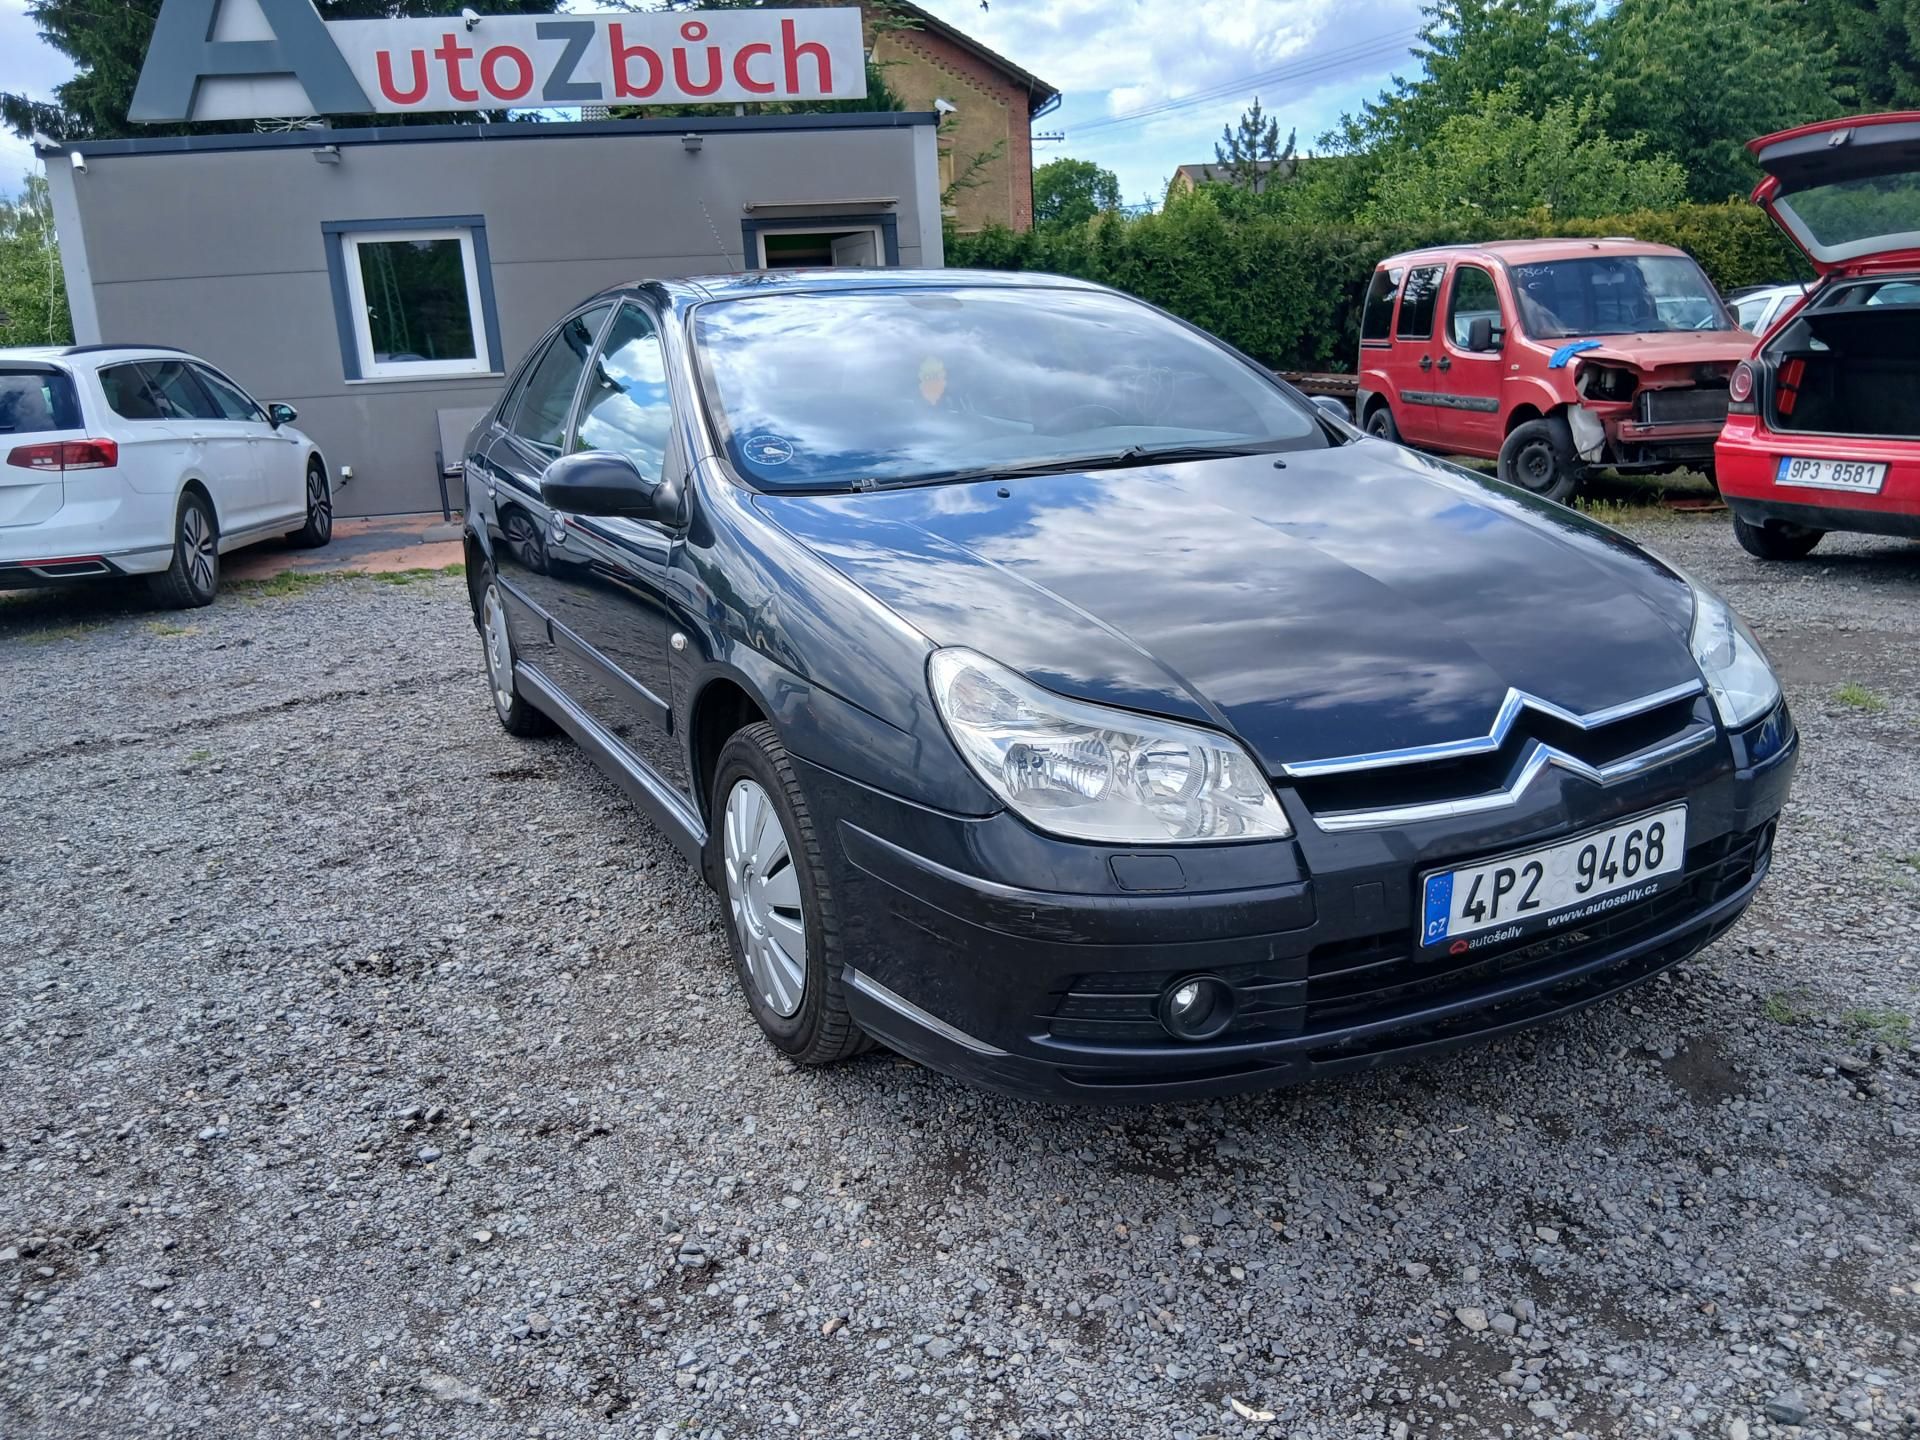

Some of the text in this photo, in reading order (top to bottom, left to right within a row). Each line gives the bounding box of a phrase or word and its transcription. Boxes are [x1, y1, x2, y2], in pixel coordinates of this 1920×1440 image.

[1791, 460, 1876, 485] 9P3 8581
[1461, 821, 1666, 923] 4P2 9468
[1547, 882, 1659, 927] www.autoselly.cz
[1428, 917, 1447, 937] CZ
